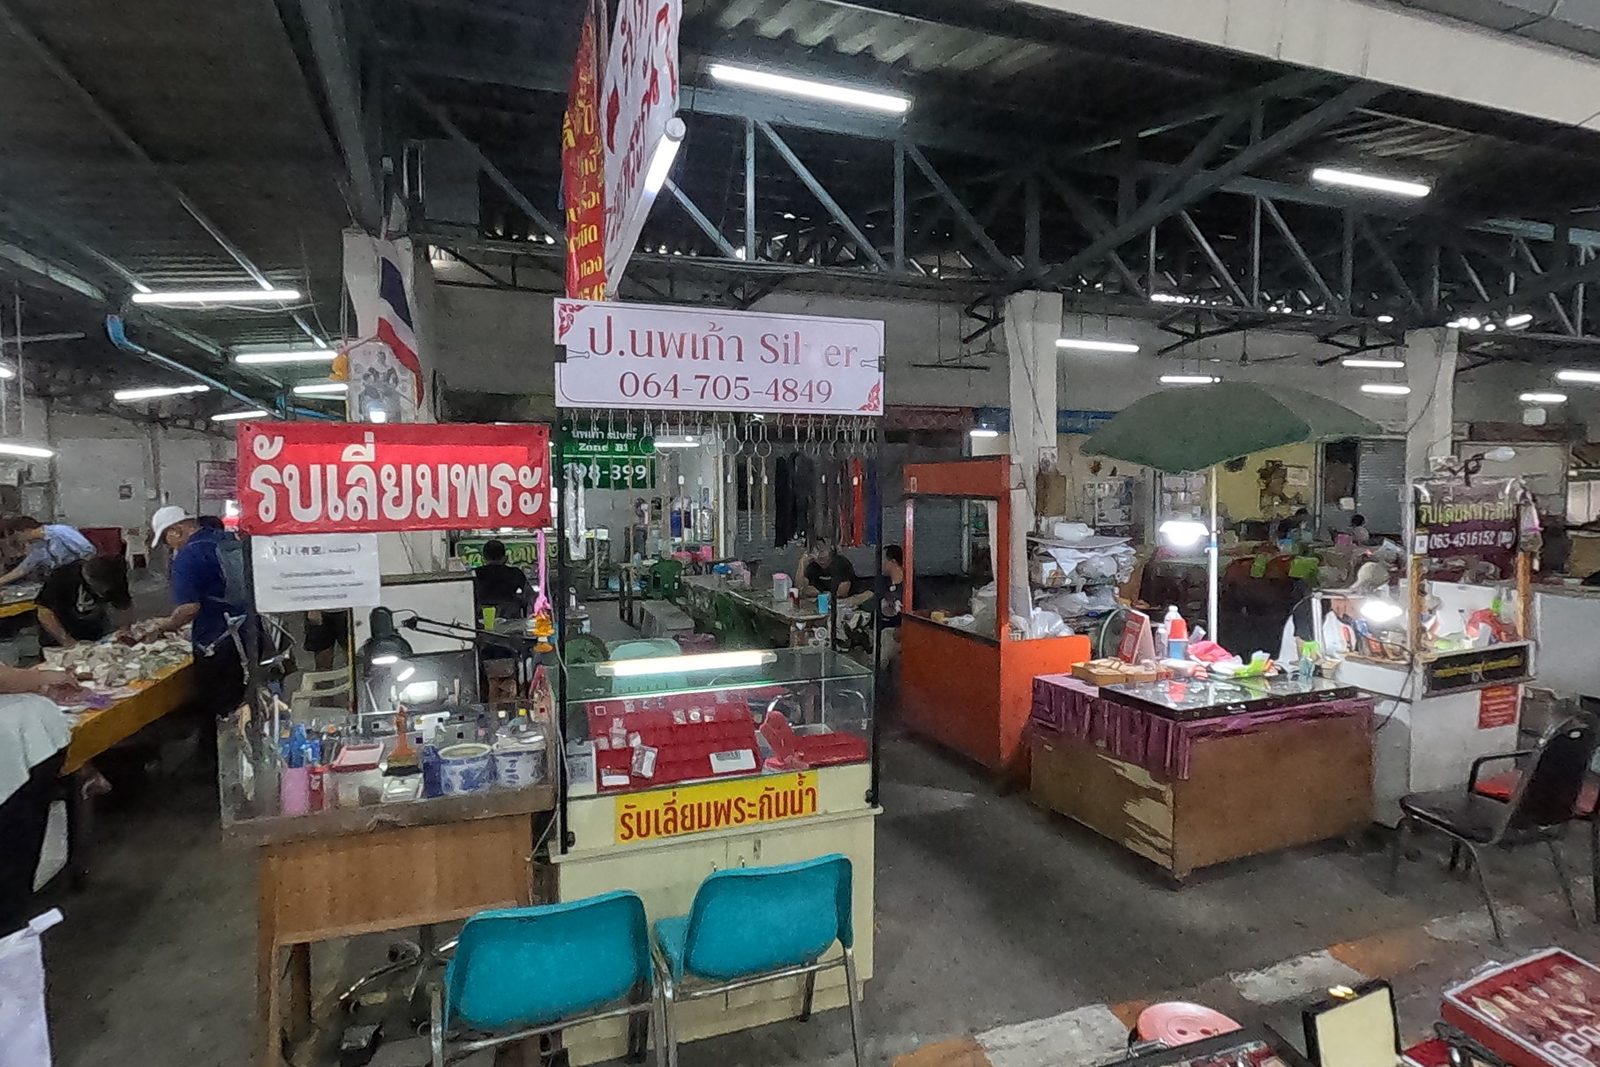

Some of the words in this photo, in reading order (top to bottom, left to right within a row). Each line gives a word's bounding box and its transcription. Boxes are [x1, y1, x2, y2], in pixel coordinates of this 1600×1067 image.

[588, 315, 744, 362] ป.นพเก้า
[759, 330, 858, 368] Siler
[618, 371, 833, 403] 064-705-4849
[249, 431, 543, 523] รับเลี่ยมพระ
[619, 773, 817, 841] รับเลี่ยมพระกันน้ำ
